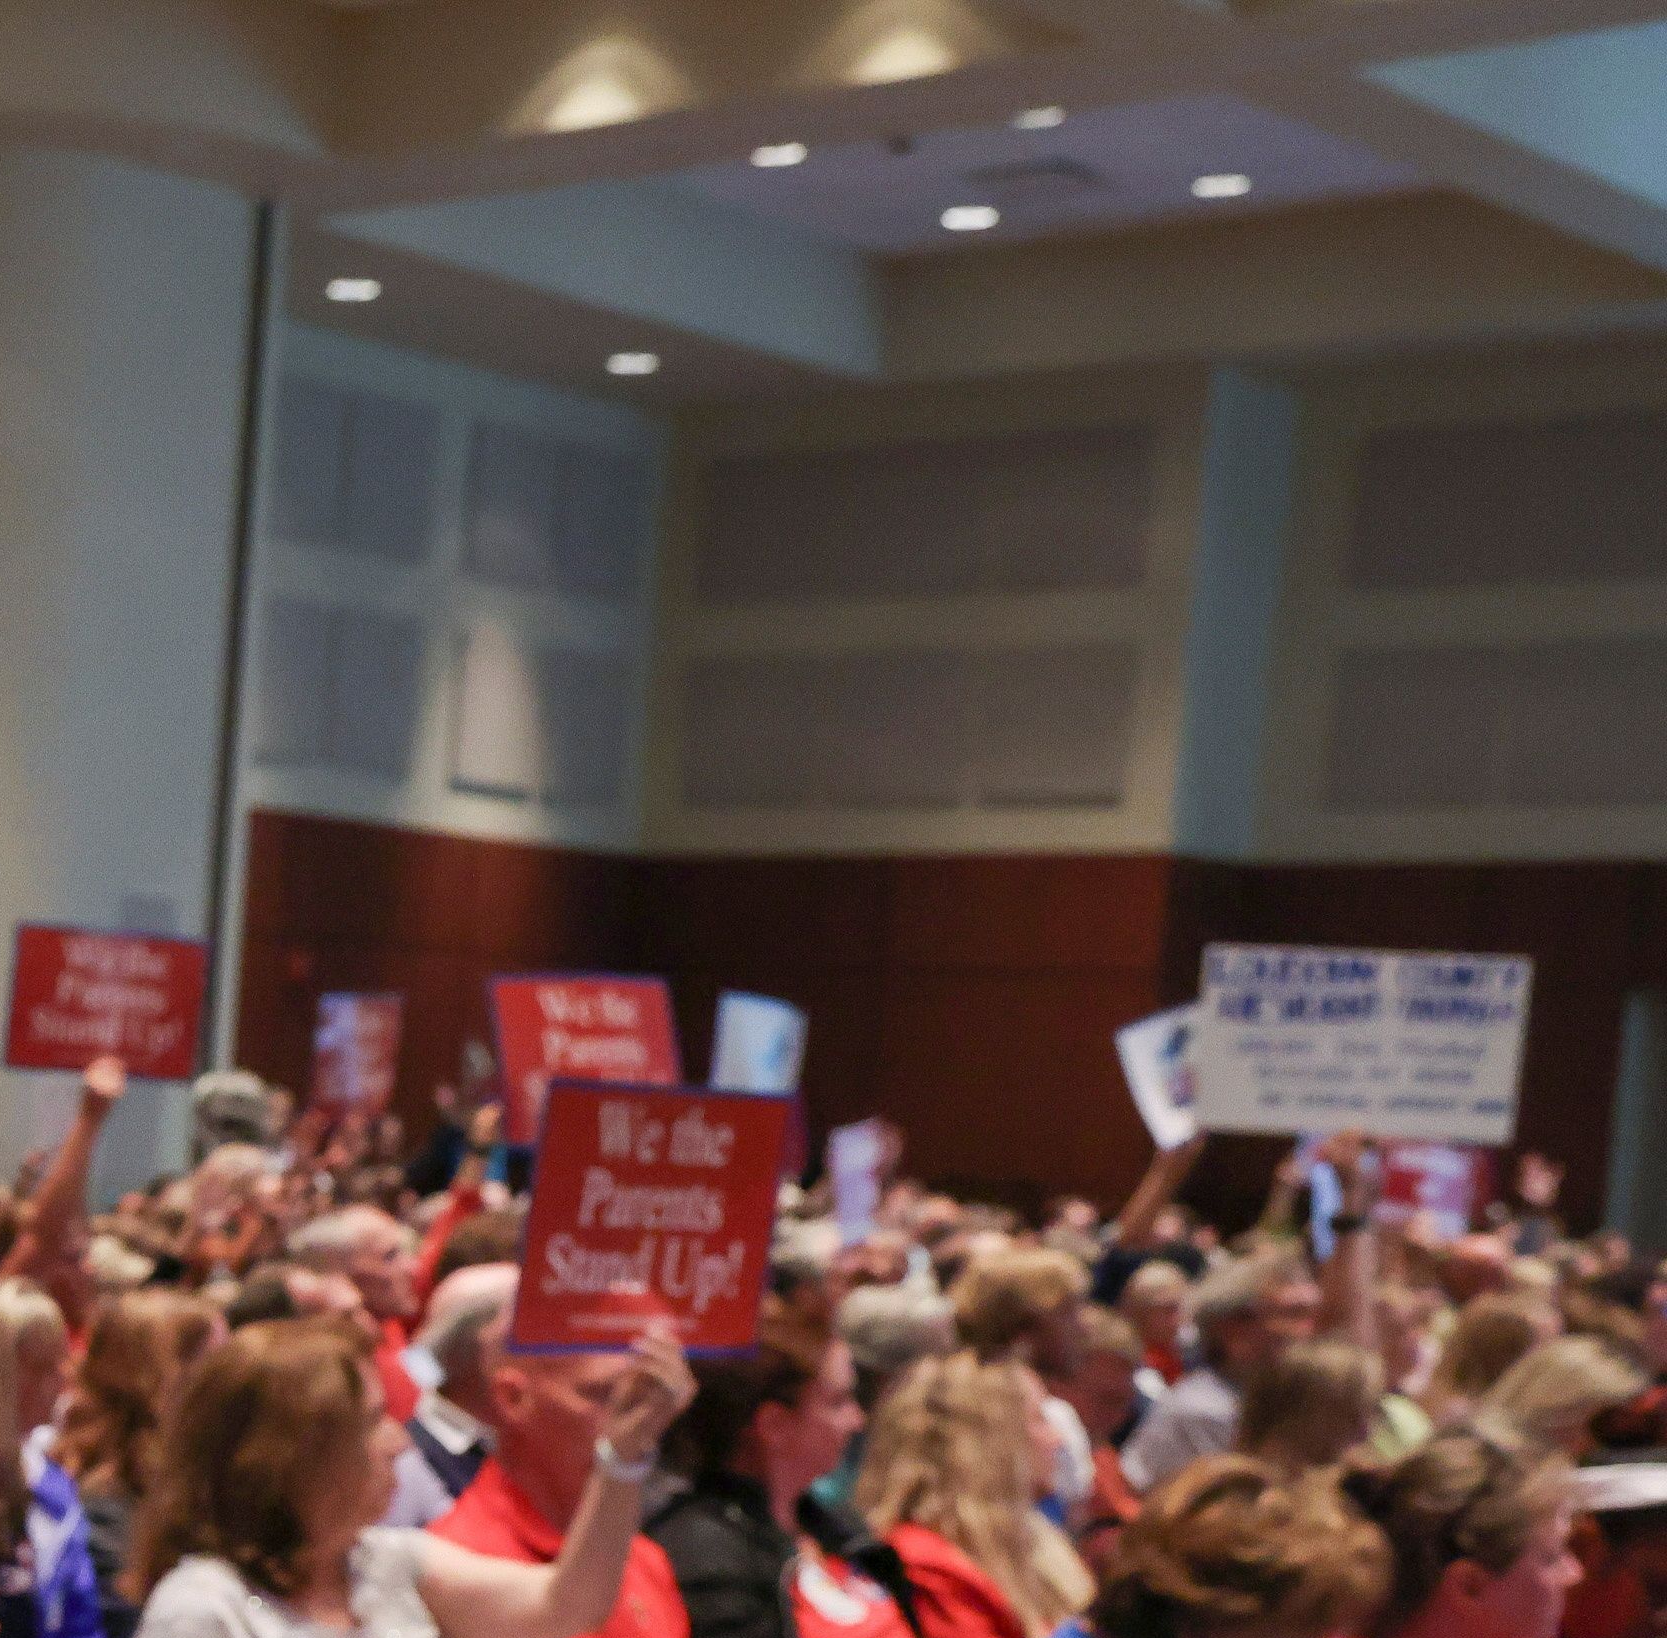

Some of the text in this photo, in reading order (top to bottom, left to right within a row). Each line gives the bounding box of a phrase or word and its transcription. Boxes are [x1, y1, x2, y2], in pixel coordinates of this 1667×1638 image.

[597, 1101, 735, 1168] We the
[578, 1166, 724, 1232] Parents
[540, 1233, 746, 1313] Stand Up!
